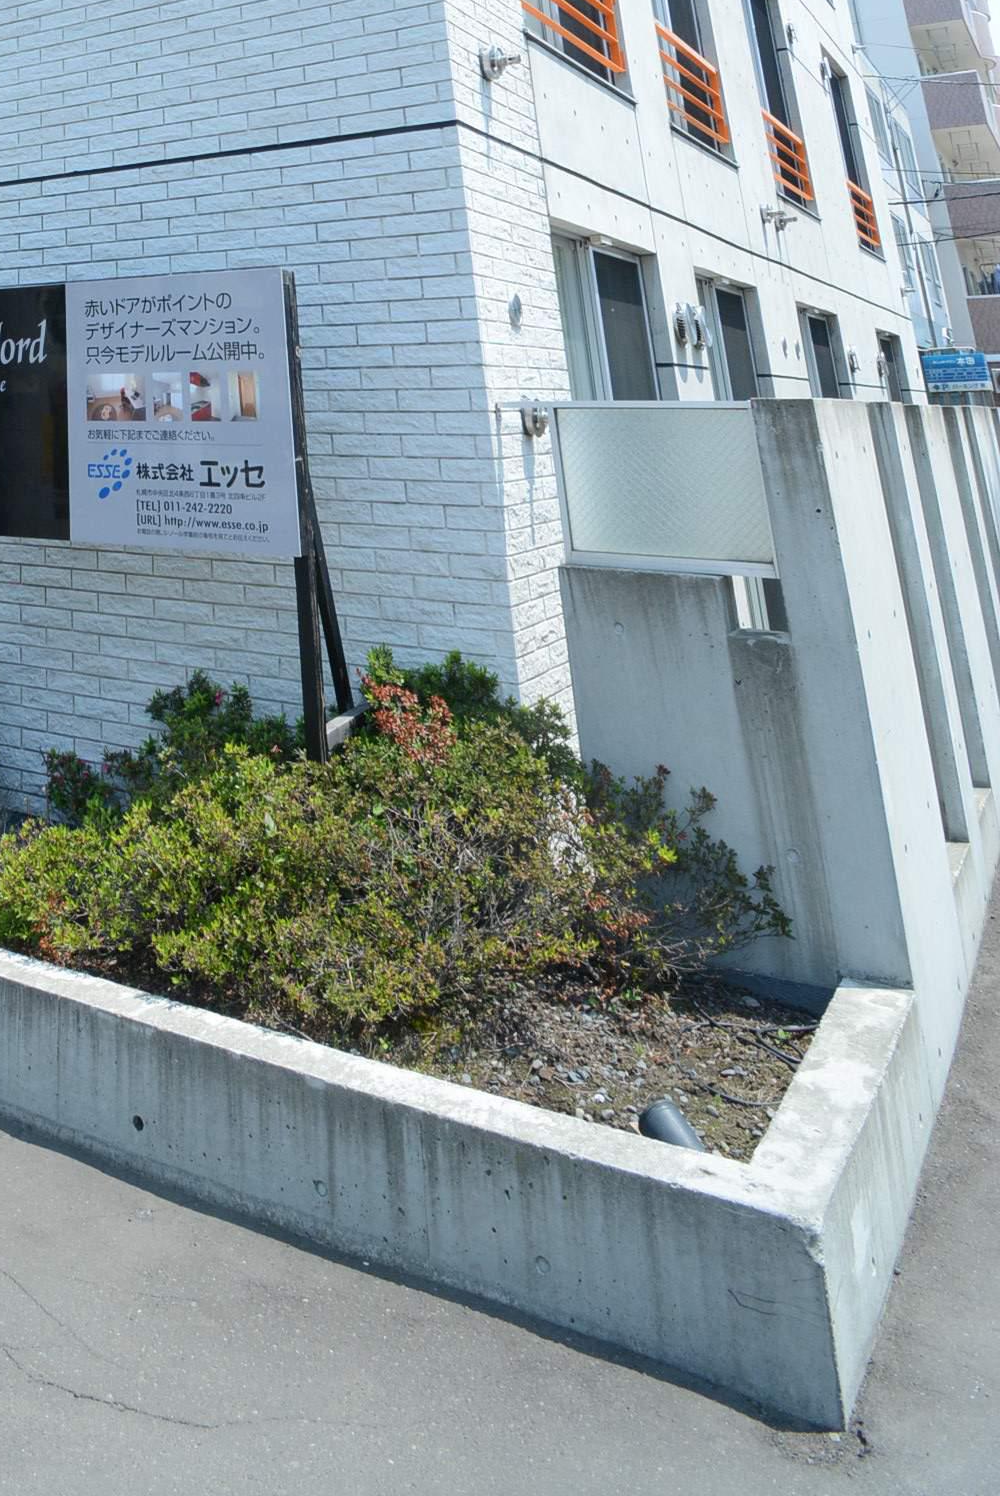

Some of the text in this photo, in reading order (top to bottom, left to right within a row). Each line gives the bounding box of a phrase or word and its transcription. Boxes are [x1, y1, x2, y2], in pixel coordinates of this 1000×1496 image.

[84, 292, 232, 318] 赤いドアがポイントの
[85, 317, 260, 341] デザイナーズマンション。
[85, 340, 265, 365] 只今モデルルーム公開中。
[87, 428, 216, 442] お気軽に下記までご連絡ください。
[87, 463, 121, 479] ESSE
[135, 459, 266, 488] 株式会社 エッセ
[136, 499, 233, 515] [TEL] 011-242-2220
[136, 514, 269, 533] [URL] http://www.esse.co.jp
